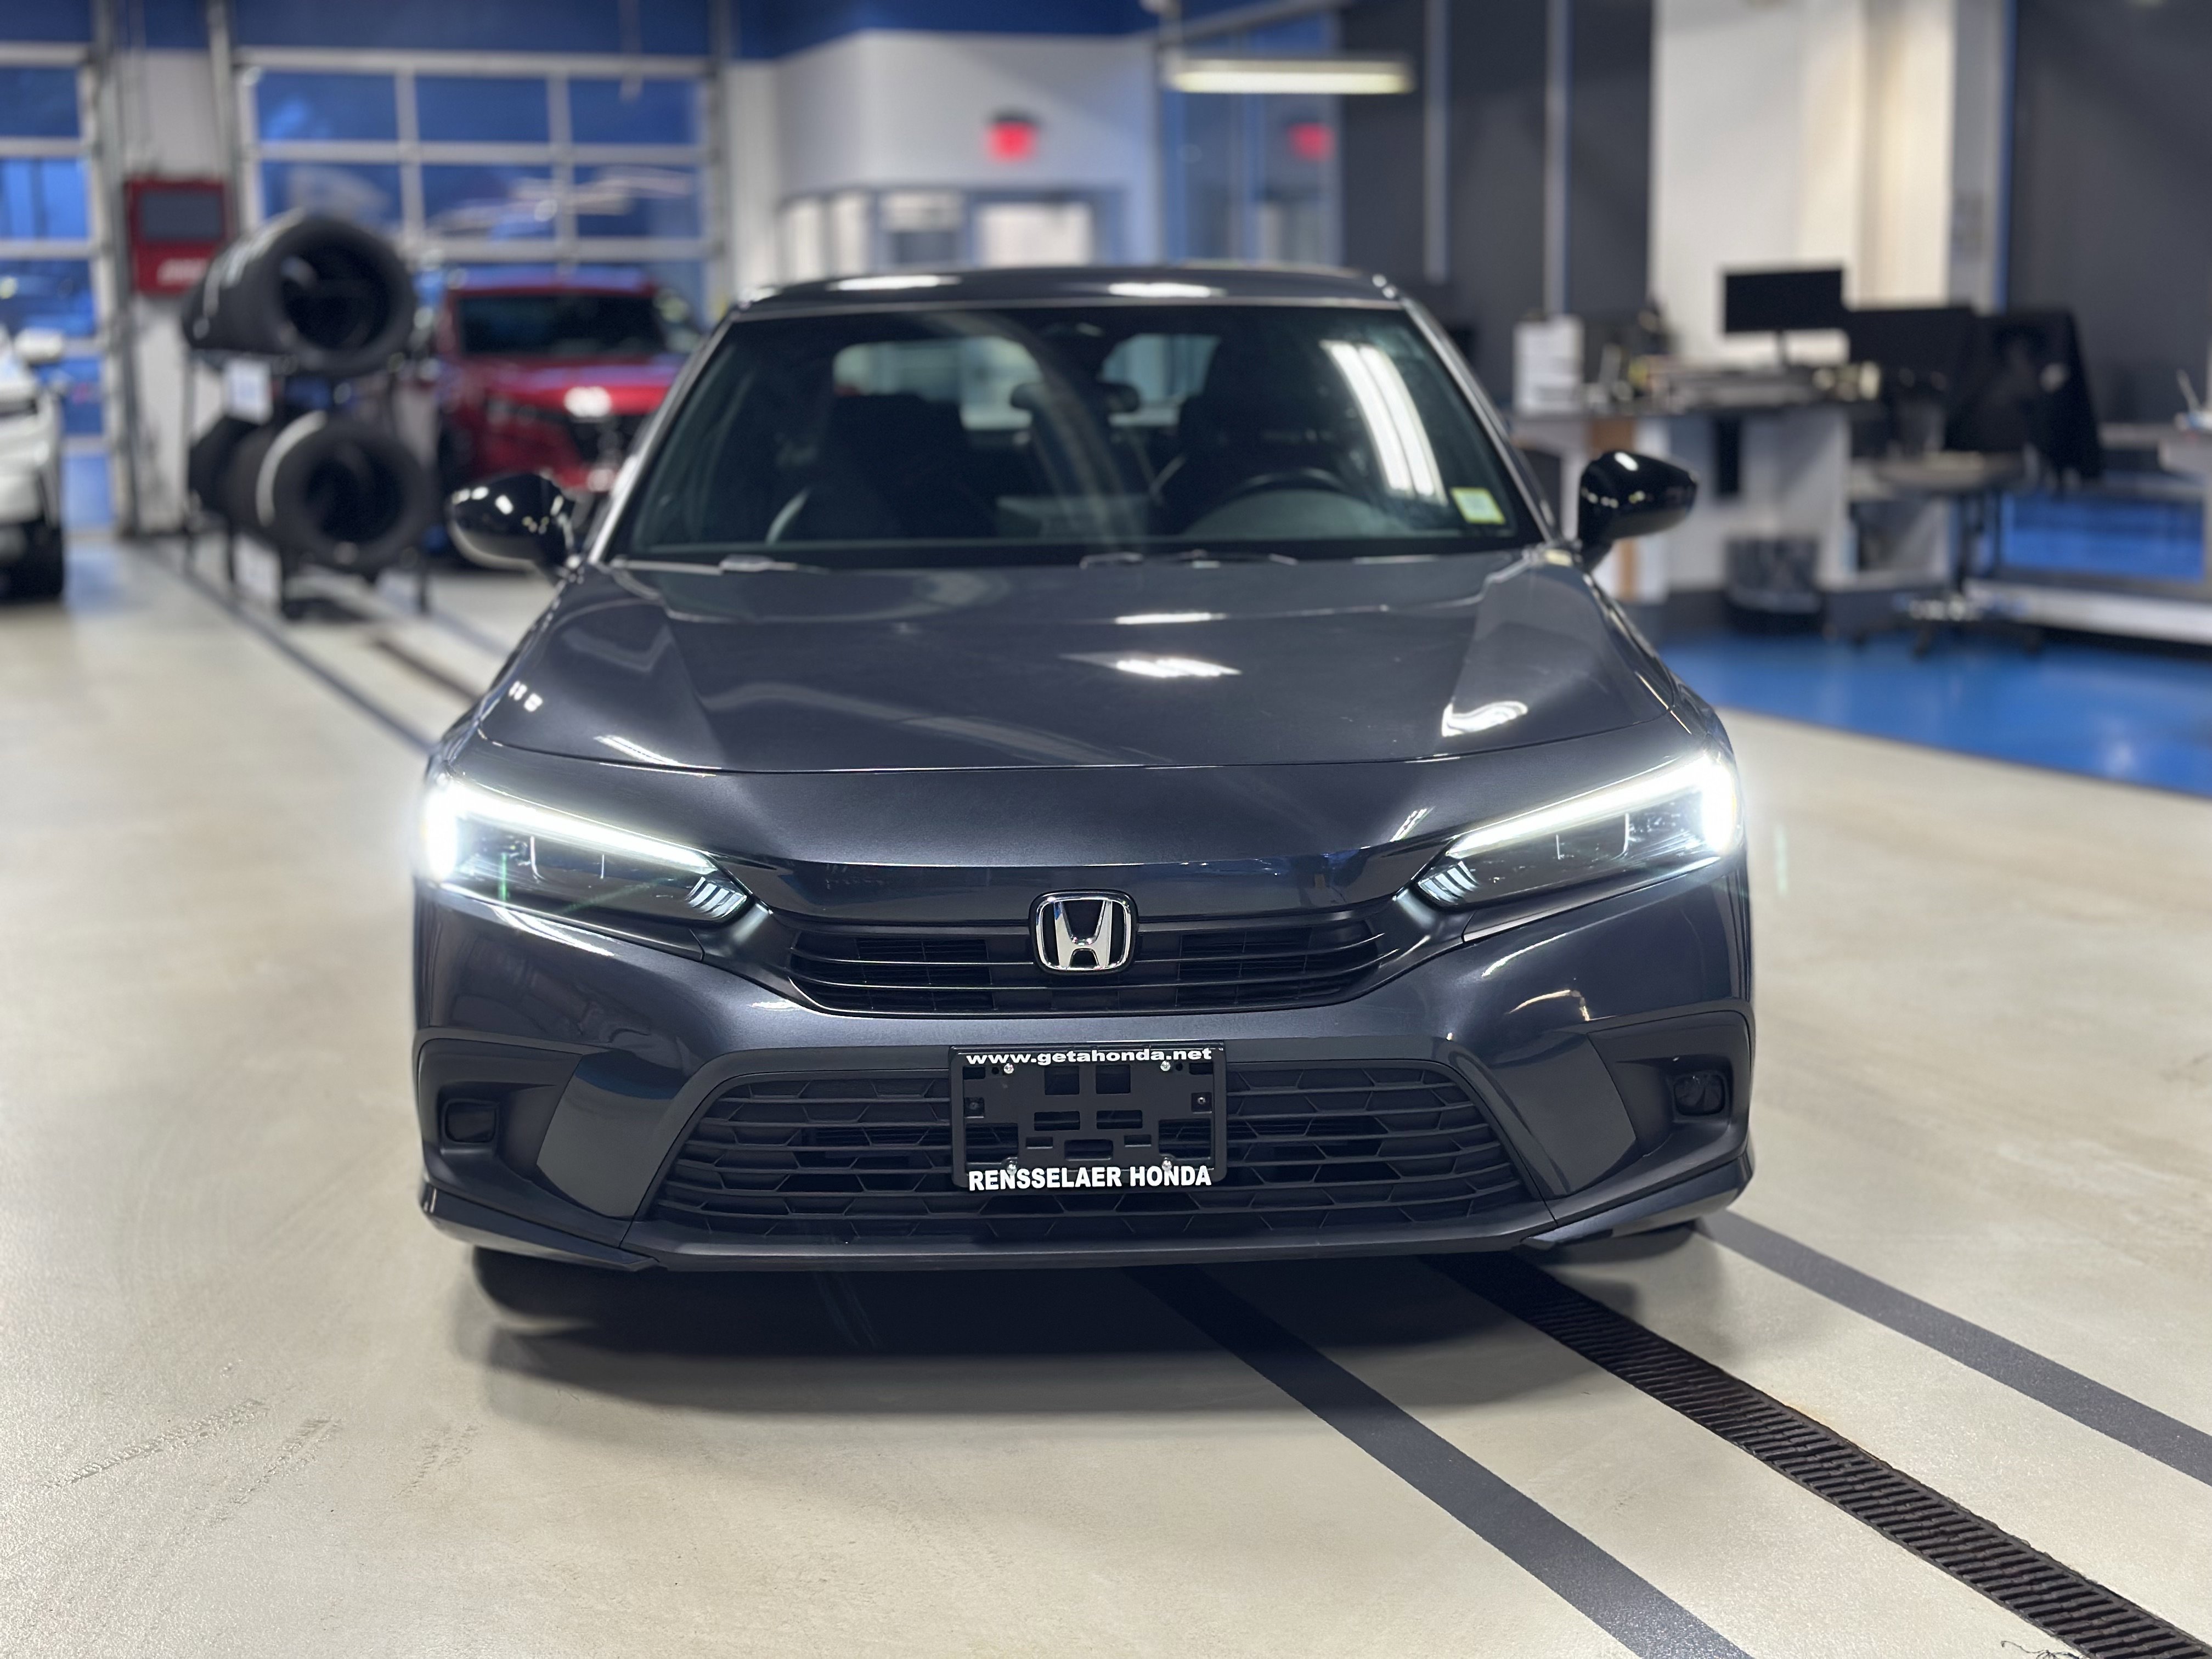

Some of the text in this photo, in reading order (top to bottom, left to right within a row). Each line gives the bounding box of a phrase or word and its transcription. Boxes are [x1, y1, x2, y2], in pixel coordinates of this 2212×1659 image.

[966, 1048, 1212, 1065] www.getahonda.net
[968, 1166, 1211, 1190] RENSSELAER HONDA
